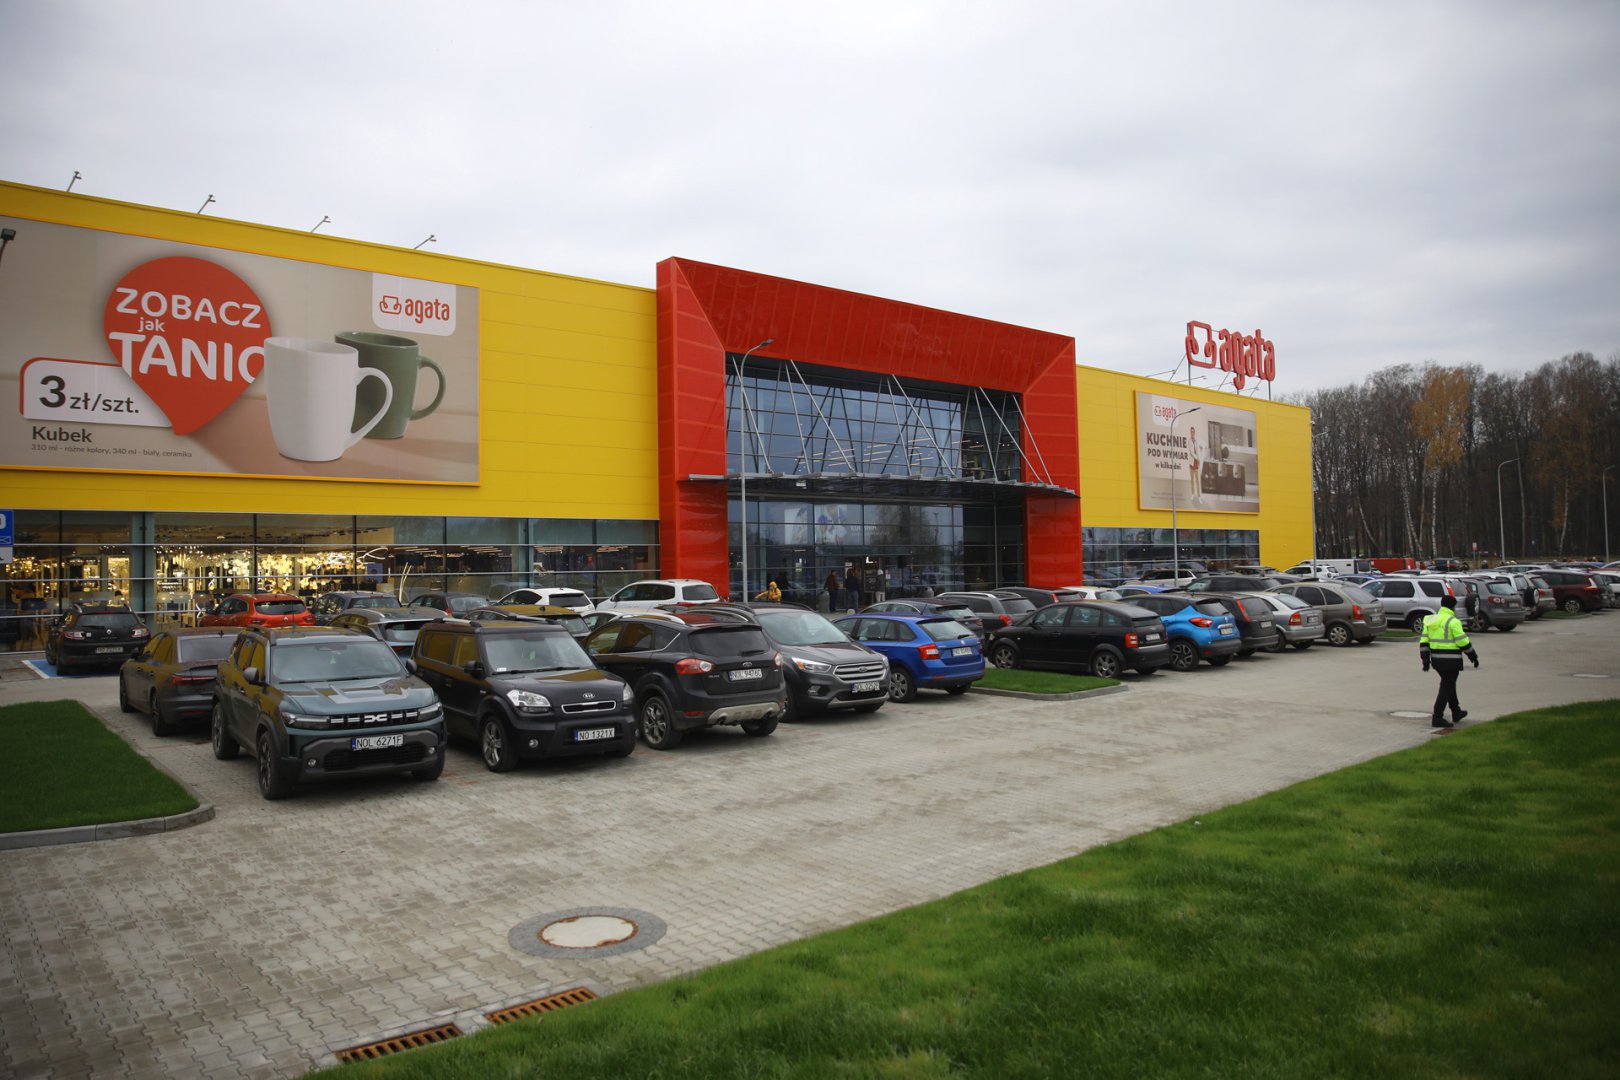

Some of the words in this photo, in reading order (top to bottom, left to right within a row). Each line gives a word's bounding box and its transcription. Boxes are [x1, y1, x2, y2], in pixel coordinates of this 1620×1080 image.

[115, 287, 262, 329] ZOBACZ
[404, 298, 450, 324] agata
[137, 317, 166, 332] jak
[1218, 328, 1276, 390] agata
[39, 375, 66, 408] 3
[69, 392, 140, 414] zł/szt.
[32, 426, 92, 443] Kubek
[1146, 432, 1187, 448] KUCHNIE
[1147, 448, 1161, 457] POD
[1162, 450, 1189, 460] WYMIAR
[356, 738, 374, 748] NOL
[375, 735, 403, 747] 6271F
[592, 728, 614, 740] 1321X
